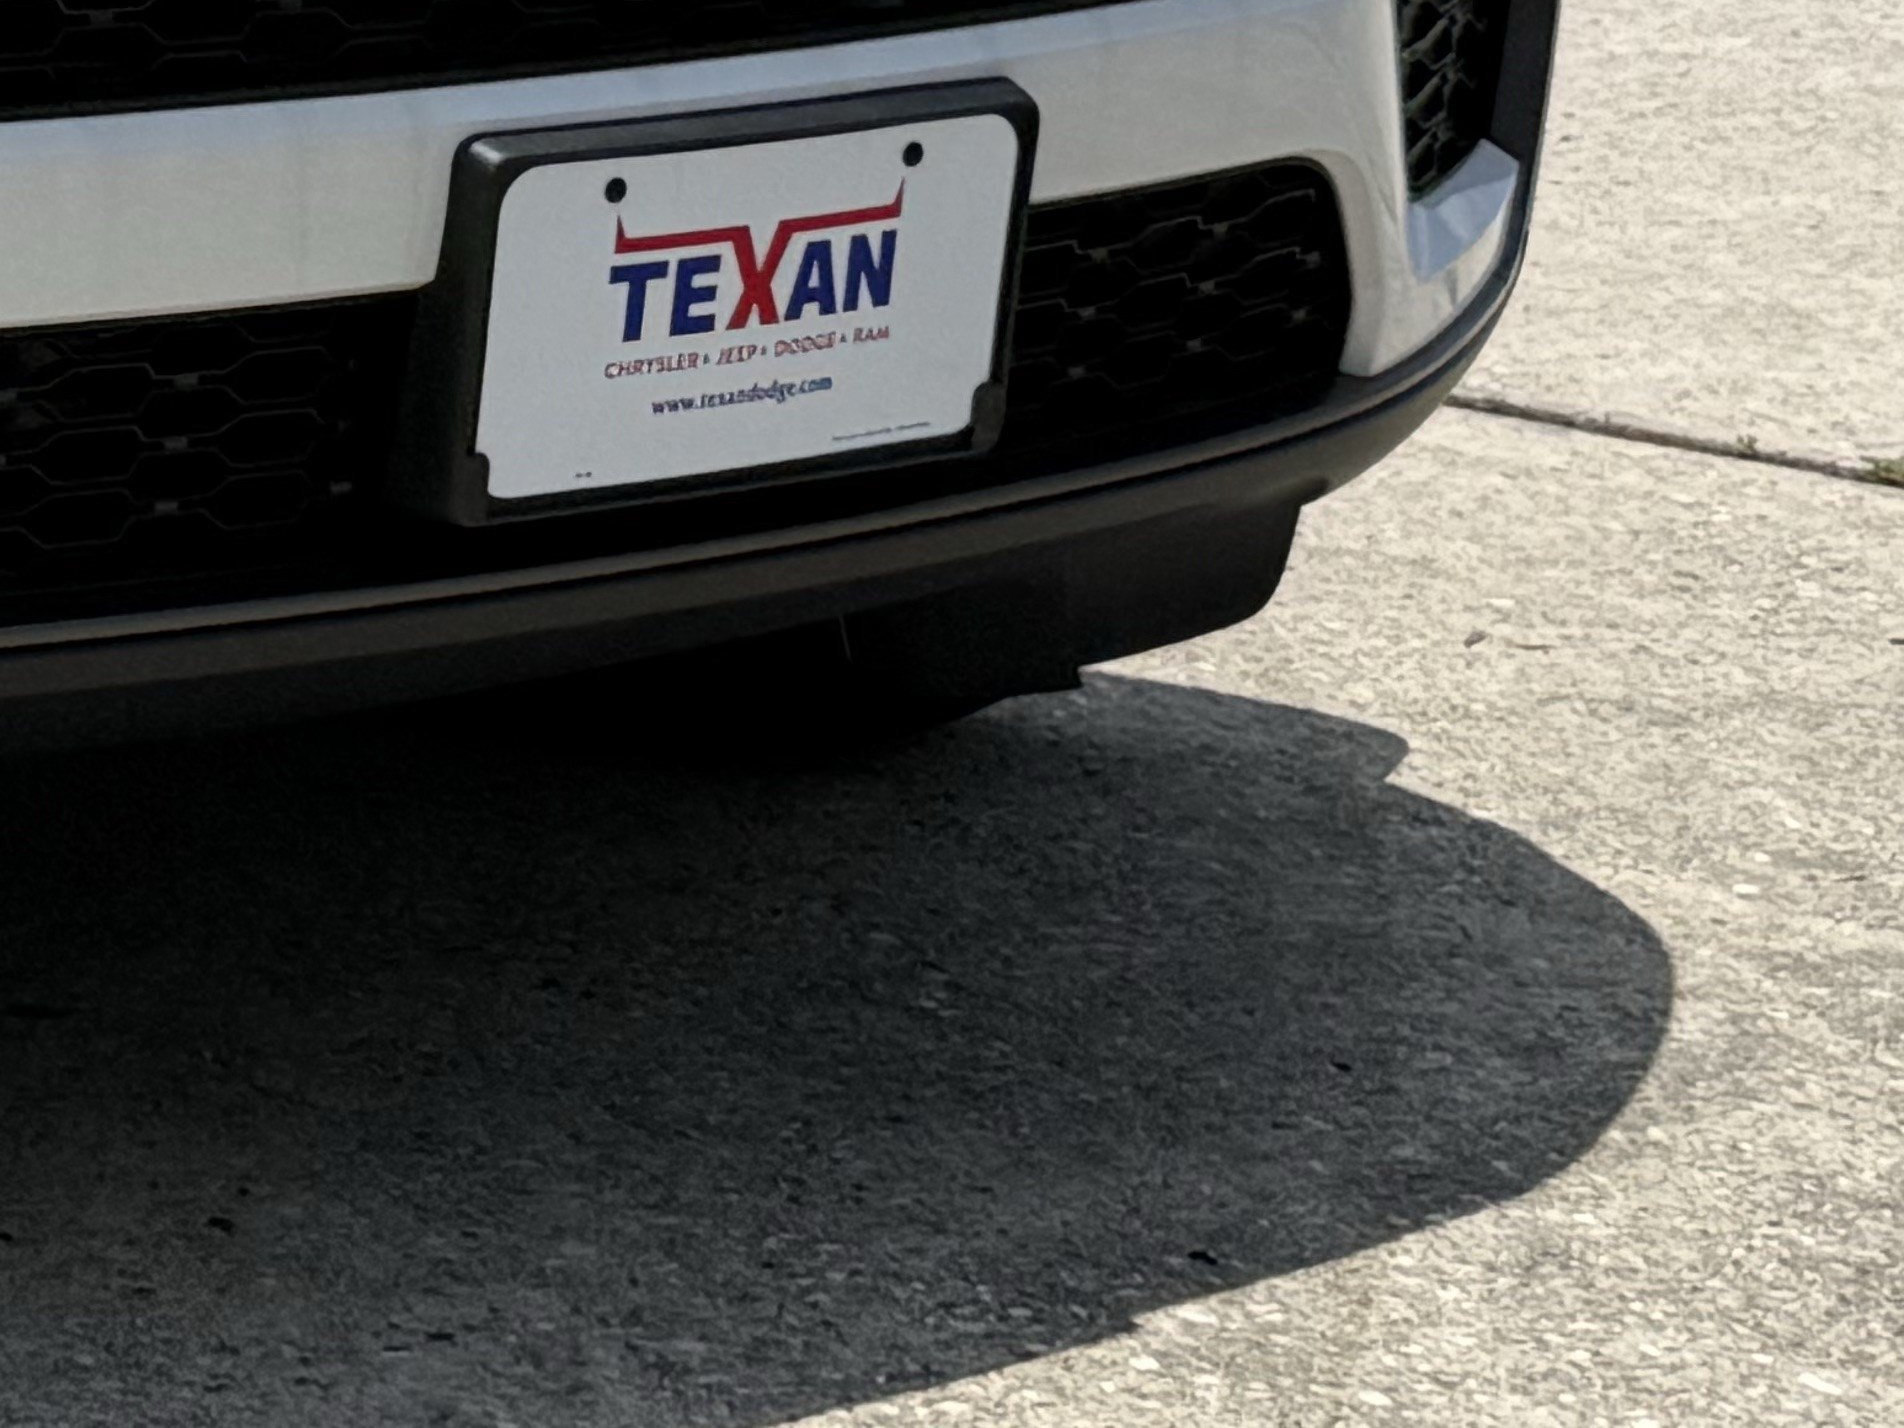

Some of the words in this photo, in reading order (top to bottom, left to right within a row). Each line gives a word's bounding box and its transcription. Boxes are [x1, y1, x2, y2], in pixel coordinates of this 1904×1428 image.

[608, 189, 905, 343] TEXAN
[604, 351, 699, 380] CHRYSLER
[774, 332, 838, 357] DODGE
[852, 325, 890, 344] RAM
